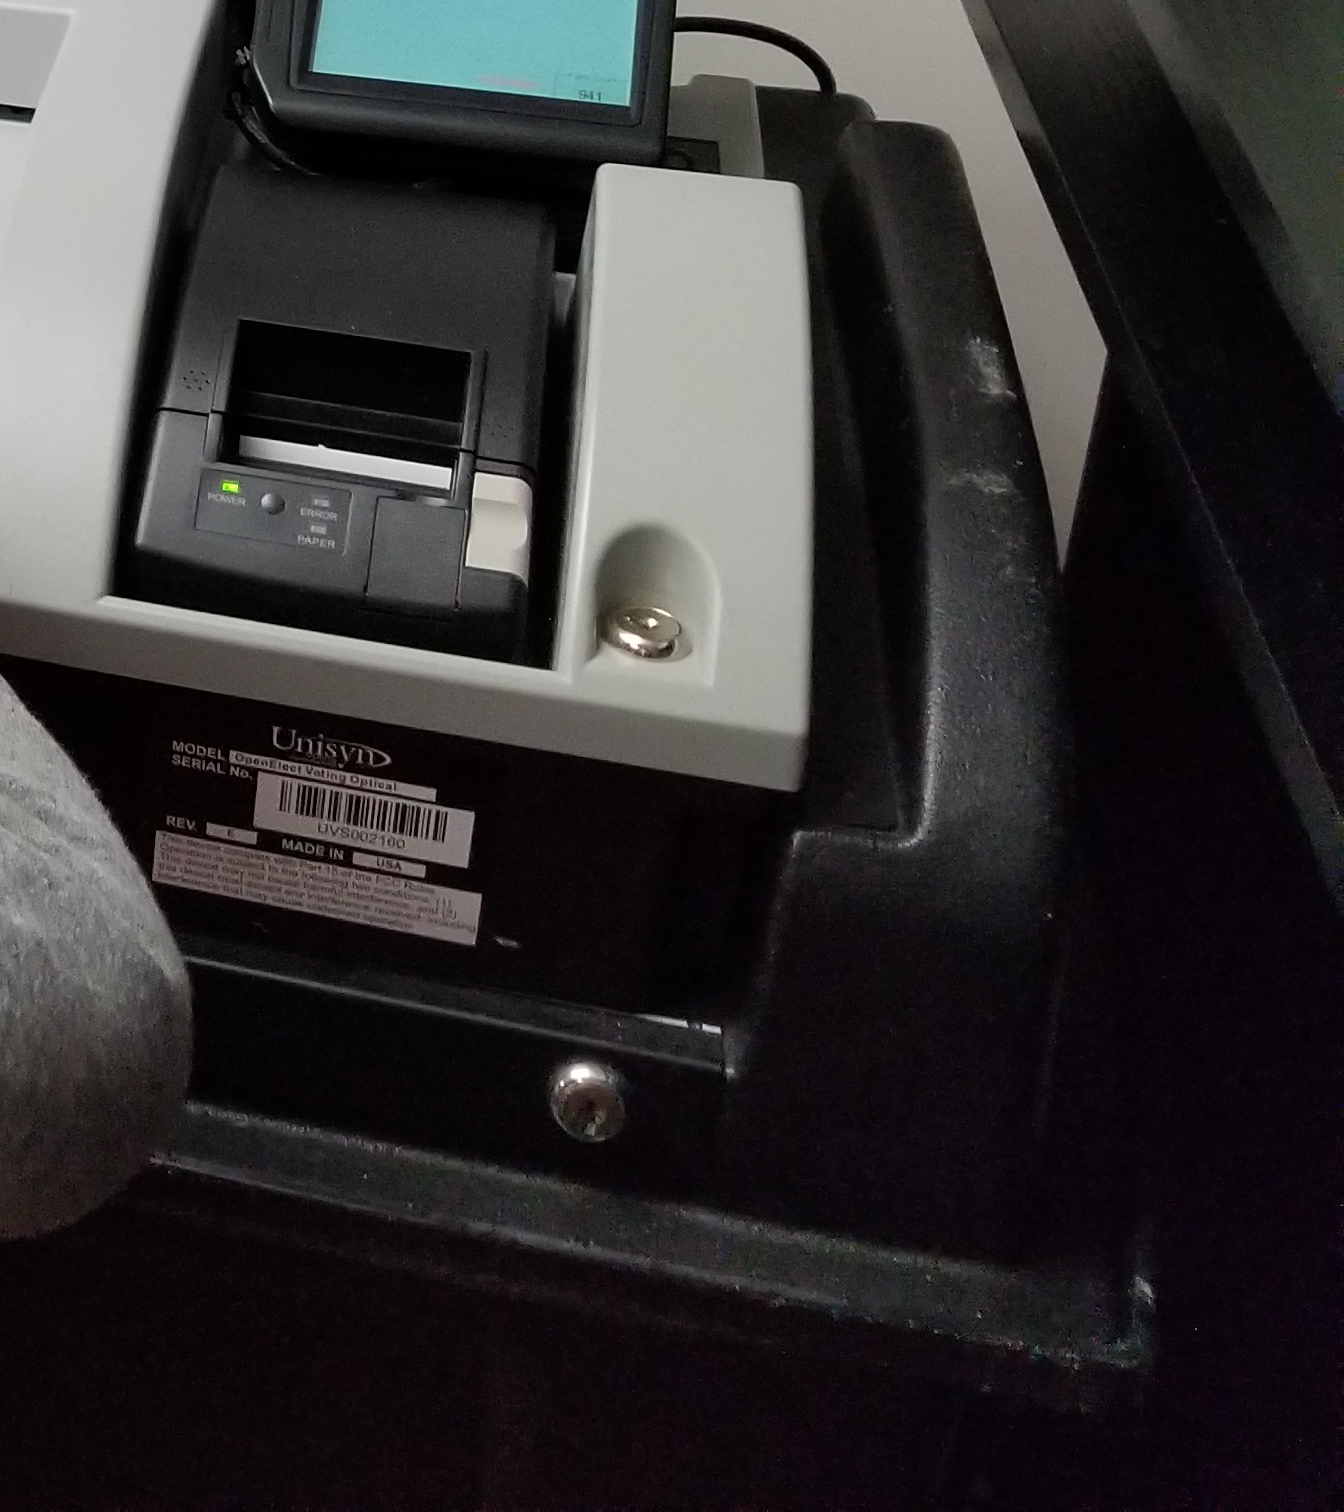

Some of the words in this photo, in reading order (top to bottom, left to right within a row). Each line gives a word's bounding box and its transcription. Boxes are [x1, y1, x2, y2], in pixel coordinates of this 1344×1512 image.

[207, 492, 247, 507] POWER
[300, 507, 338, 522] ERROR
[297, 534, 336, 549] PAPER
[271, 725, 390, 769] Unisyn
[171, 753, 226, 775] SERIAL
[229, 765, 253, 780] No.
[172, 740, 226, 761] MODEL
[305, 764, 347, 784] Voting
[349, 774, 398, 793] Optical
[281, 838, 326, 856] MADE
[329, 847, 344, 861] IN
[375, 857, 403, 871] USA
